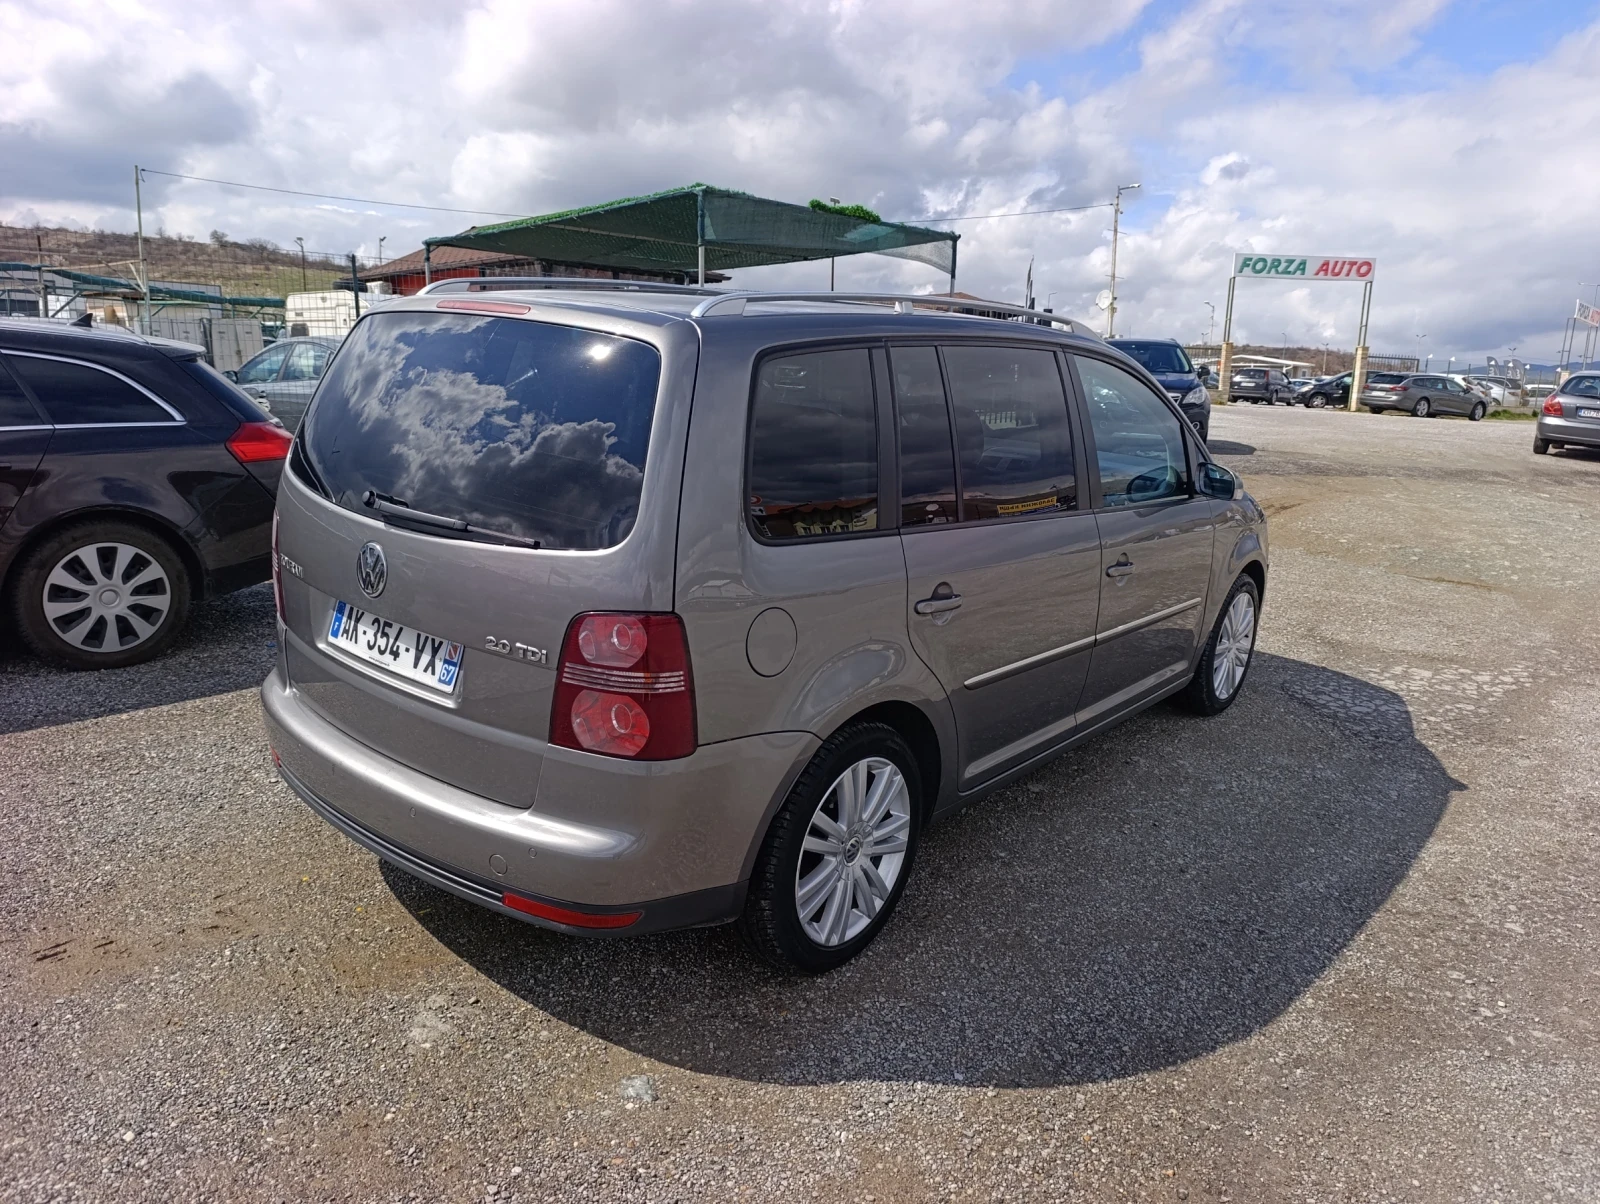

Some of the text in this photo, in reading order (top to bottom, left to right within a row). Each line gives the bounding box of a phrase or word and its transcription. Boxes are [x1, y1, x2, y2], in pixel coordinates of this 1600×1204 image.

[1238, 257, 1372, 277] FORZA AUTO
[440, 663, 455, 682] 67
